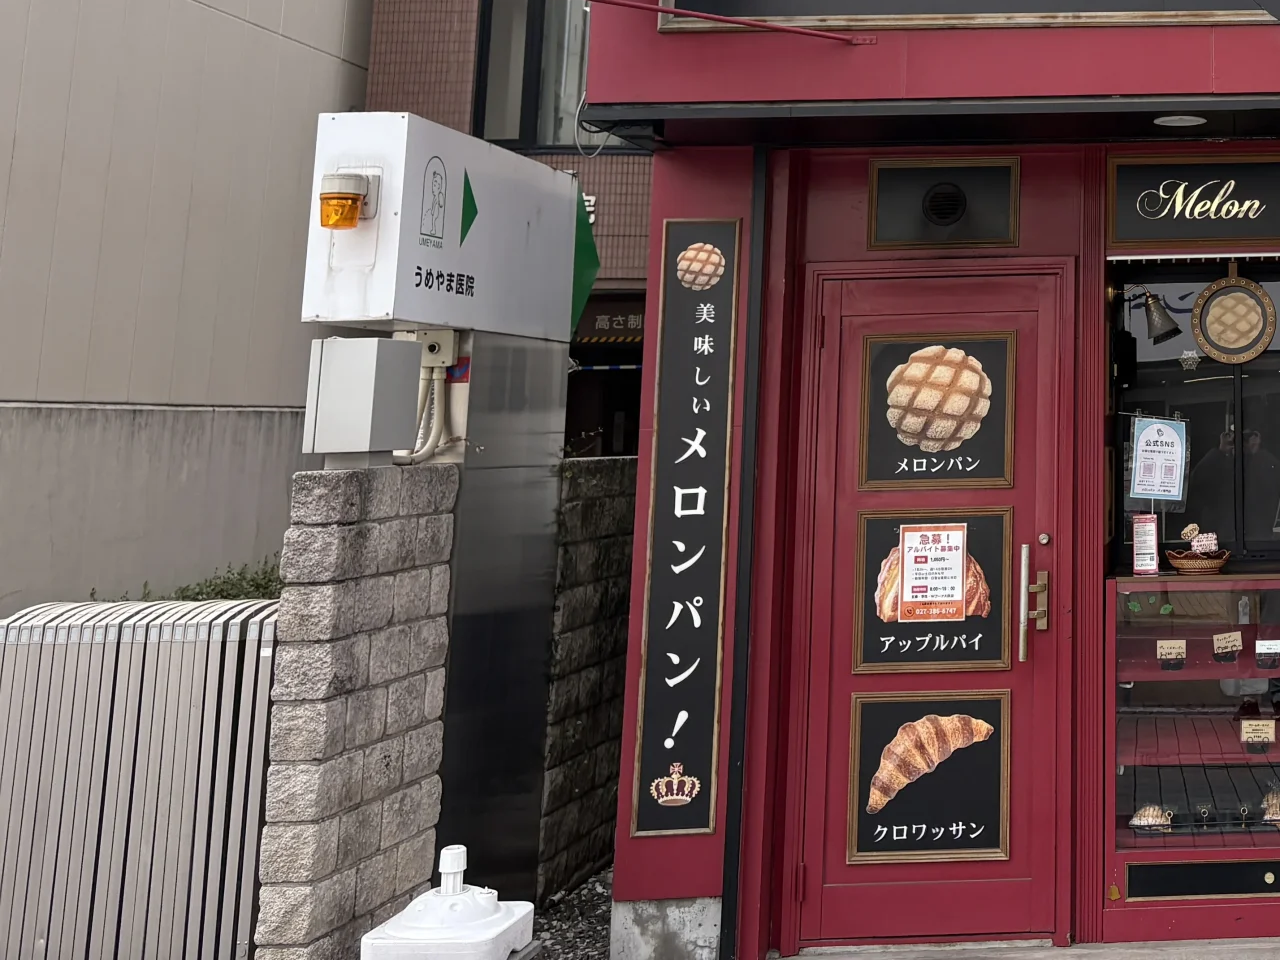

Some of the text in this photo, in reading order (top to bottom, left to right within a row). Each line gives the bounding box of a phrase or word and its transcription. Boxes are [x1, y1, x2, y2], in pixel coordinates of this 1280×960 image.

[1136, 179, 1267, 220] Melon
[418, 237, 443, 249] UMEYAMA
[414, 265, 475, 297] うめやま医院
[1144, 439, 1175, 448] 公式SNS
[894, 456, 981, 474] メロンパン
[907, 545, 960, 553] アルバイト募集中
[879, 633, 983, 653] アップルパイ
[873, 821, 985, 842] クロワッサン
